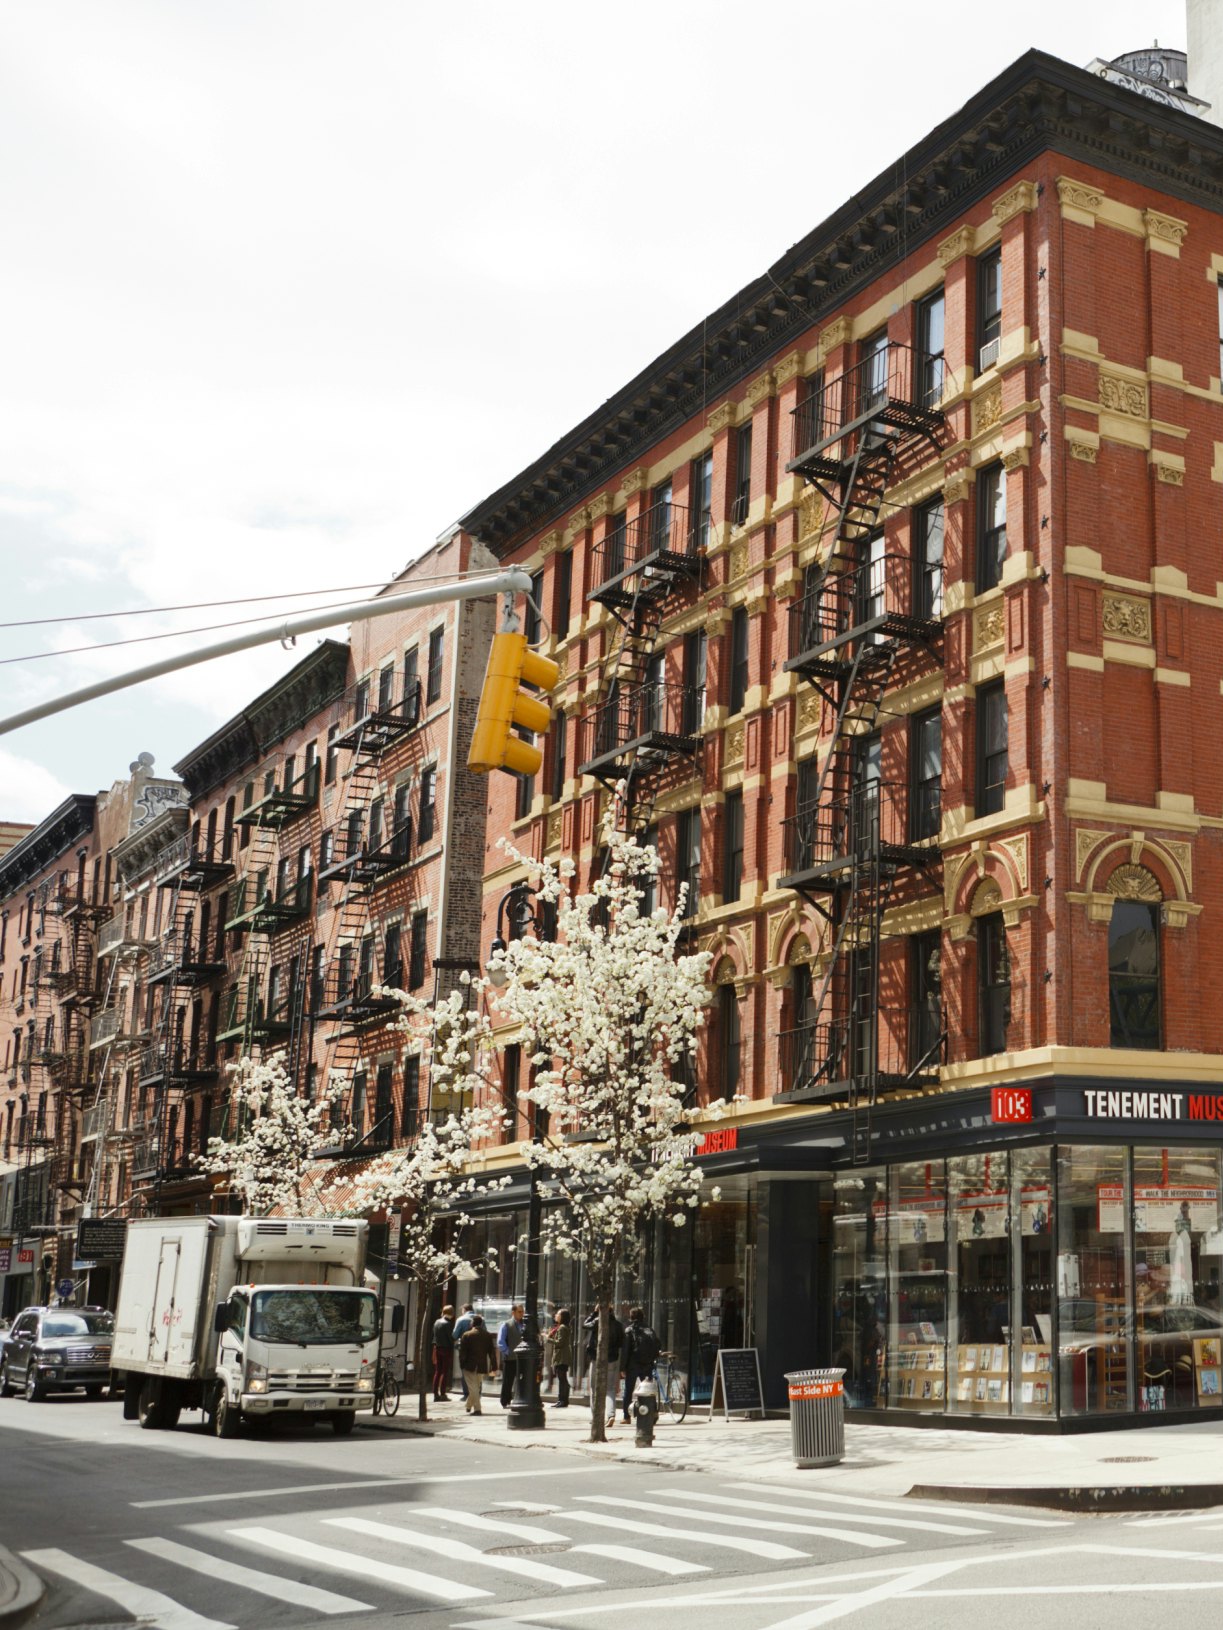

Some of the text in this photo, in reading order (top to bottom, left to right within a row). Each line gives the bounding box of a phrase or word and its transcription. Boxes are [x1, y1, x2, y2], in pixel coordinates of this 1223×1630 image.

[998, 1091, 1025, 1118] 103
[1084, 1090, 1183, 1119] TENEMENT
[803, 1385, 821, 1396] Side
[822, 1384, 834, 1394] NY
